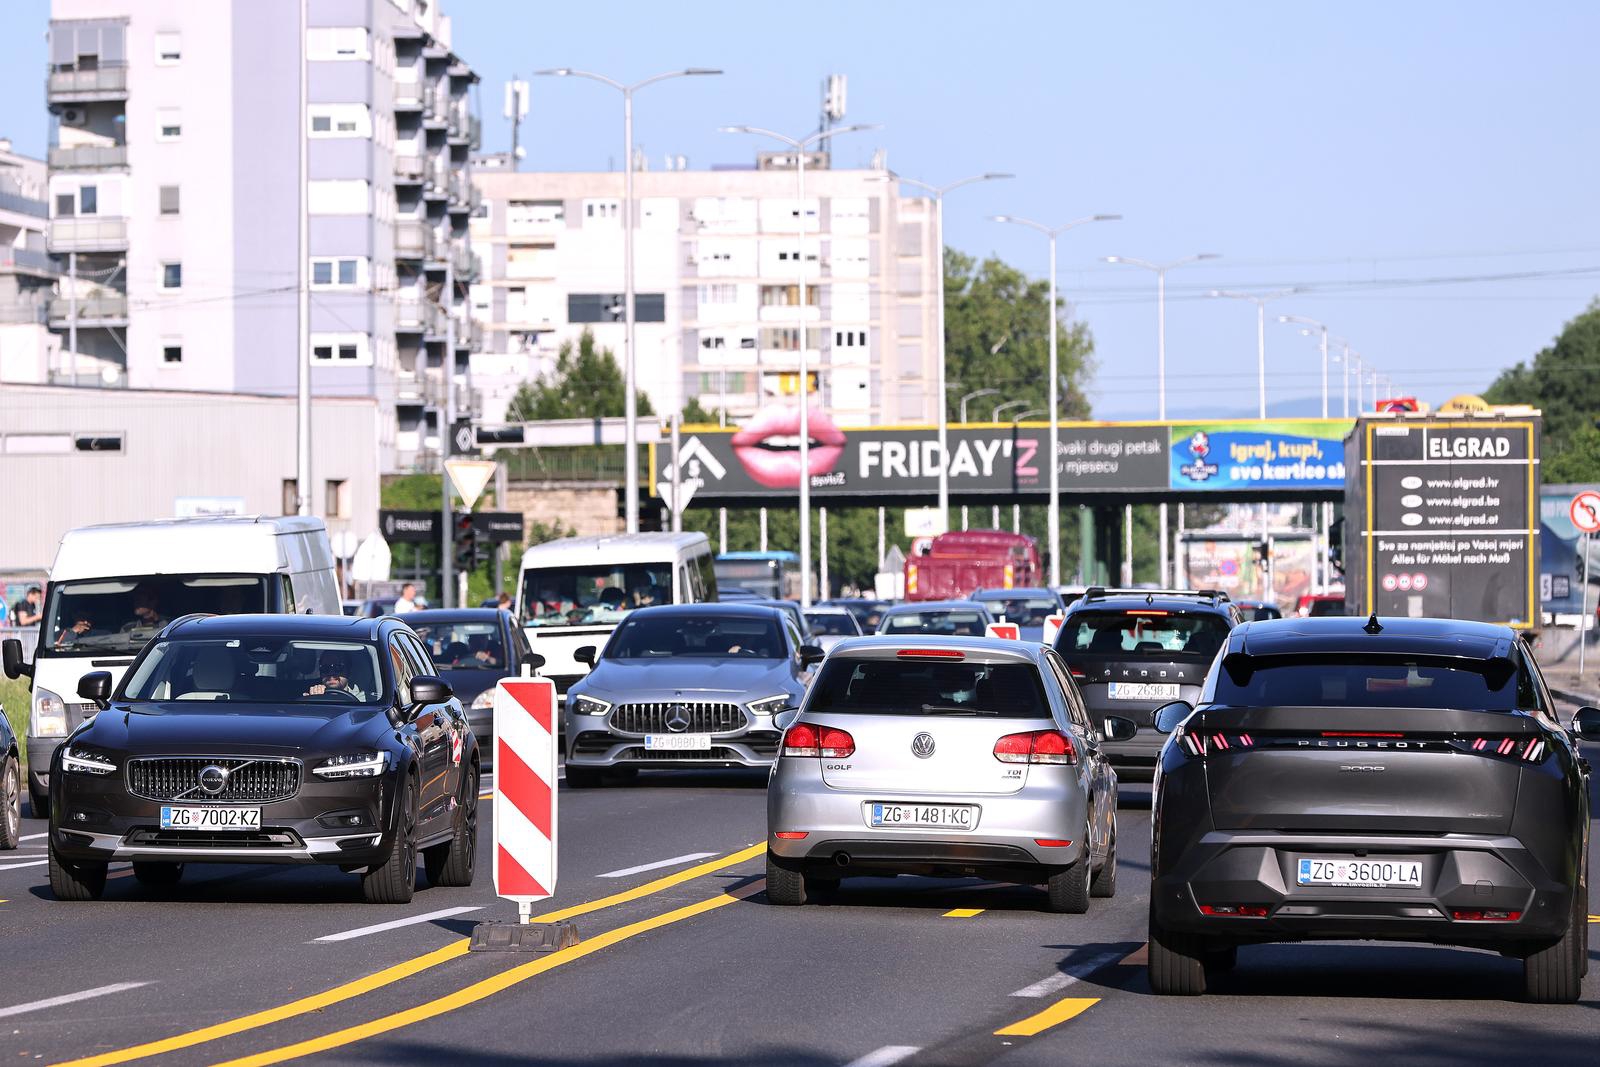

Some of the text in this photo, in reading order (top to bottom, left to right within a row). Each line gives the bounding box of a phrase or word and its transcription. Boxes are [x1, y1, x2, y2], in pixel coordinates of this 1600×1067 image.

[1088, 439, 1122, 457] drugi
[1125, 438, 1161, 456] petak
[1231, 440, 1323, 463] Igraj, kupi,
[1429, 437, 1511, 458] ELGRAD
[1065, 458, 1119, 476] mjesecu
[1262, 461, 1326, 479] kartice
[1427, 476, 1499, 490] www.elgrad.hr
[1426, 495, 1500, 509] www.elgrad.ba
[1427, 513, 1499, 527] www.elgrad.at
[1378, 540, 1395, 551] Sve
[1397, 542, 1408, 551] za
[1457, 541, 1470, 552] po
[1391, 553, 1415, 565] Alles
[1416, 553, 1430, 565] für
[1116, 684, 1130, 696] ZG
[653, 737, 665, 748] ZG
[1298, 740, 1427, 749] PEUGEOT
[172, 809, 190, 825] ZG
[884, 806, 902, 822] ZG
[1313, 862, 1335, 880] ZG
